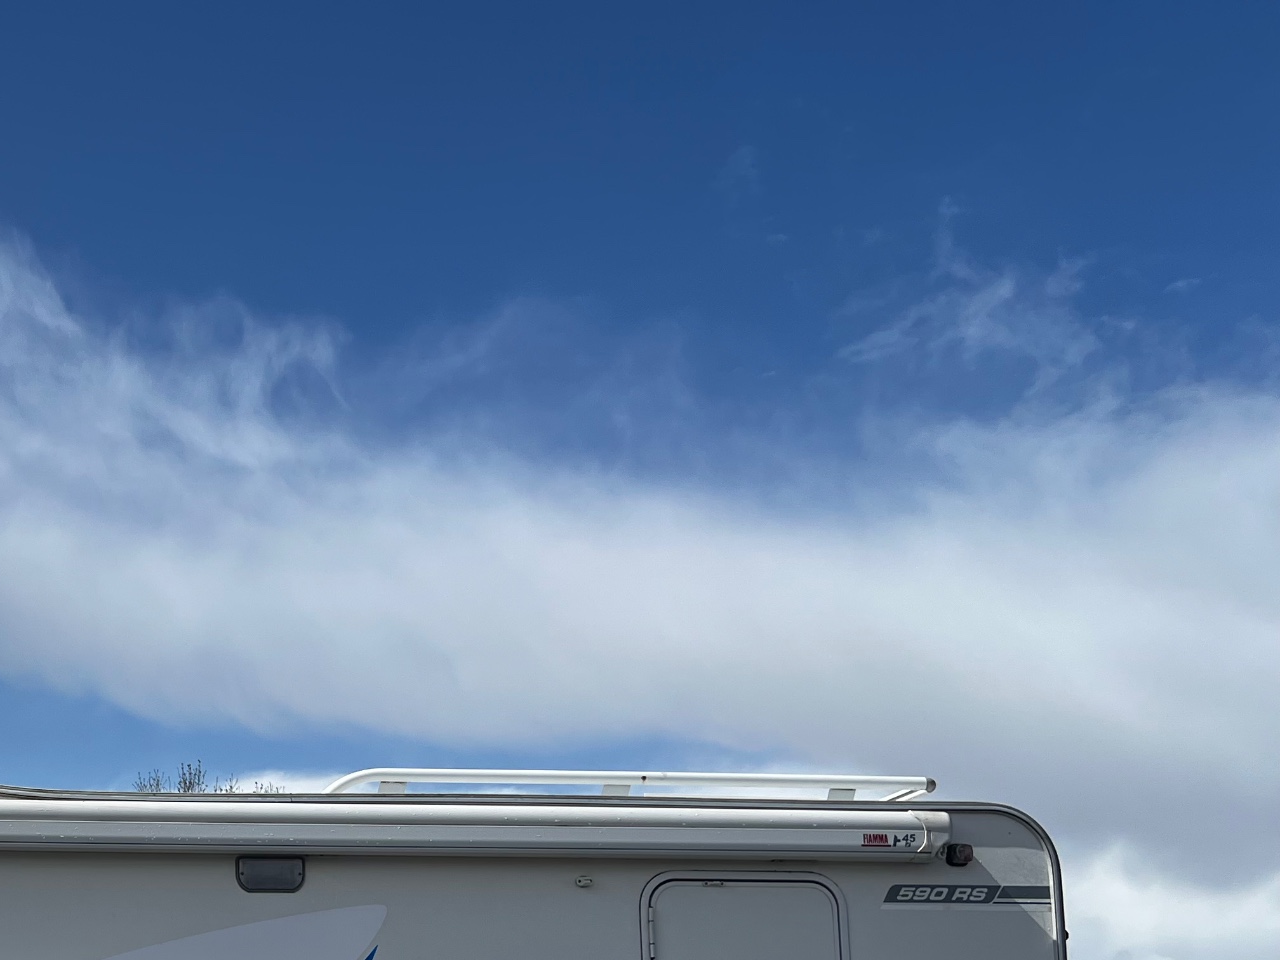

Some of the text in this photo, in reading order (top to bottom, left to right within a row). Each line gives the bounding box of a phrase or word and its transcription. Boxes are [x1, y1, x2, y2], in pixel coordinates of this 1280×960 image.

[862, 833, 889, 844] FIAMMA
[896, 887, 988, 901] 590 RS
